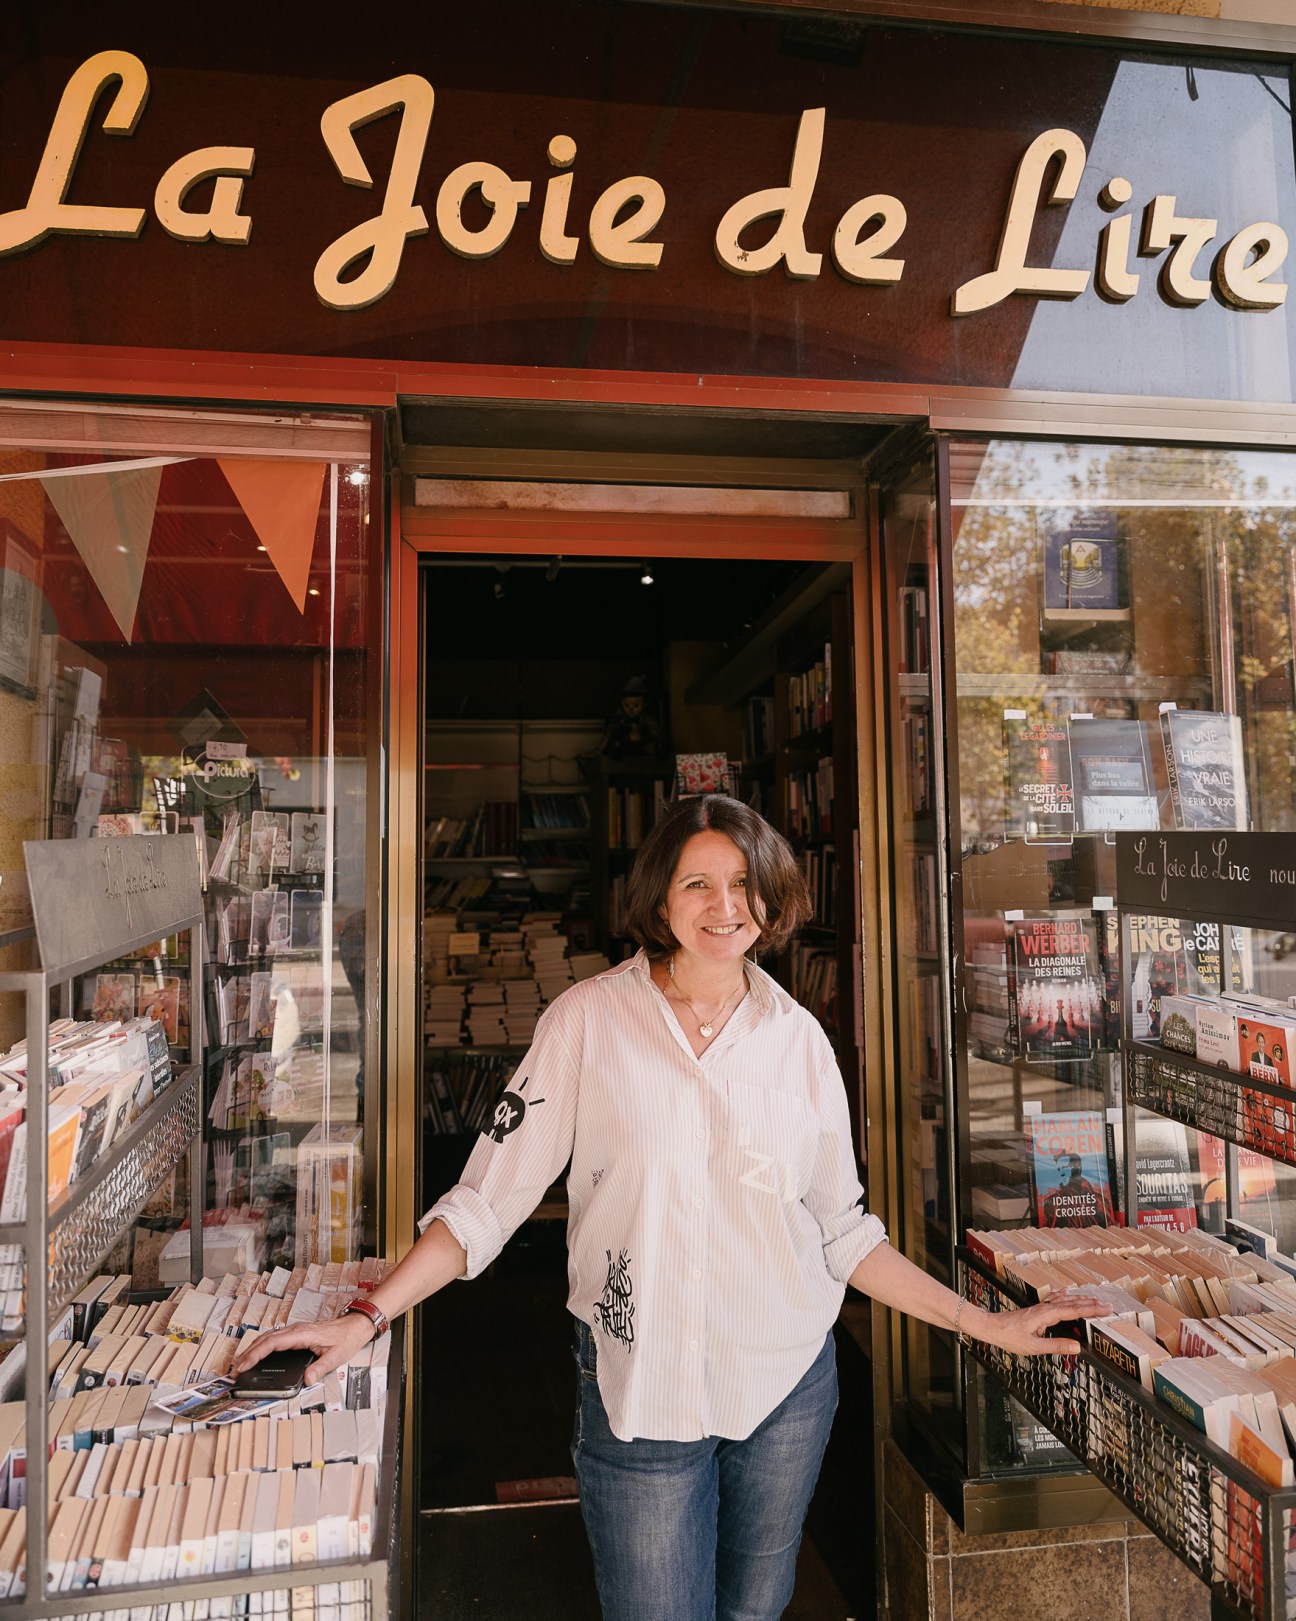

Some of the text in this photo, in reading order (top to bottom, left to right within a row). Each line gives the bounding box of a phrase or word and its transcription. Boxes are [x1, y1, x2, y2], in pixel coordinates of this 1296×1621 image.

[0, 50, 1290, 317] La Joie de Lire
[1031, 723, 1056, 732] GILLES
[1020, 732, 1066, 741] LEGARDINIER
[1190, 729, 1218, 743] UNE
[1091, 771, 1120, 779] Plus bas
[1165, 744, 1180, 806] ERIK LARSON
[1192, 771, 1231, 785] VRAIE
[1024, 784, 1056, 794] SECRET
[1092, 779, 1140, 787] dans la vallée
[1035, 793, 1056, 804] CITÉ
[1188, 797, 1207, 807] ERIK
[1043, 803, 1075, 814] SOLEIL
[1134, 836, 1156, 875] La
[1159, 838, 1187, 902] Joie
[1190, 850, 1209, 880] de
[1212, 837, 1251, 882] Lire
[1033, 922, 1077, 936] BERNARD
[1193, 922, 1219, 937] JOH
[1021, 934, 1091, 956] WERBER
[1183, 935, 1195, 951] le
[1029, 955, 1087, 967] LA DIAGONALE
[1035, 965, 1082, 977] DES REINES
[1166, 1030, 1192, 1044] CHANCES
[1252, 1067, 1278, 1084] BERN
[1034, 1116, 1101, 1135] HARLAN
[1035, 1134, 1103, 1156] COBEN
[1244, 1156, 1257, 1166] VIE
[1052, 1192, 1097, 1206] IDENTITÉS
[1055, 1204, 1097, 1217] CROISÉES
[1094, 1332, 1137, 1378] ELIZABETH
[1162, 1385, 1196, 1418] CHRISTIAN
[1034, 1434, 1045, 1442] LES
[1036, 1441, 1055, 1450] JAMAIS
